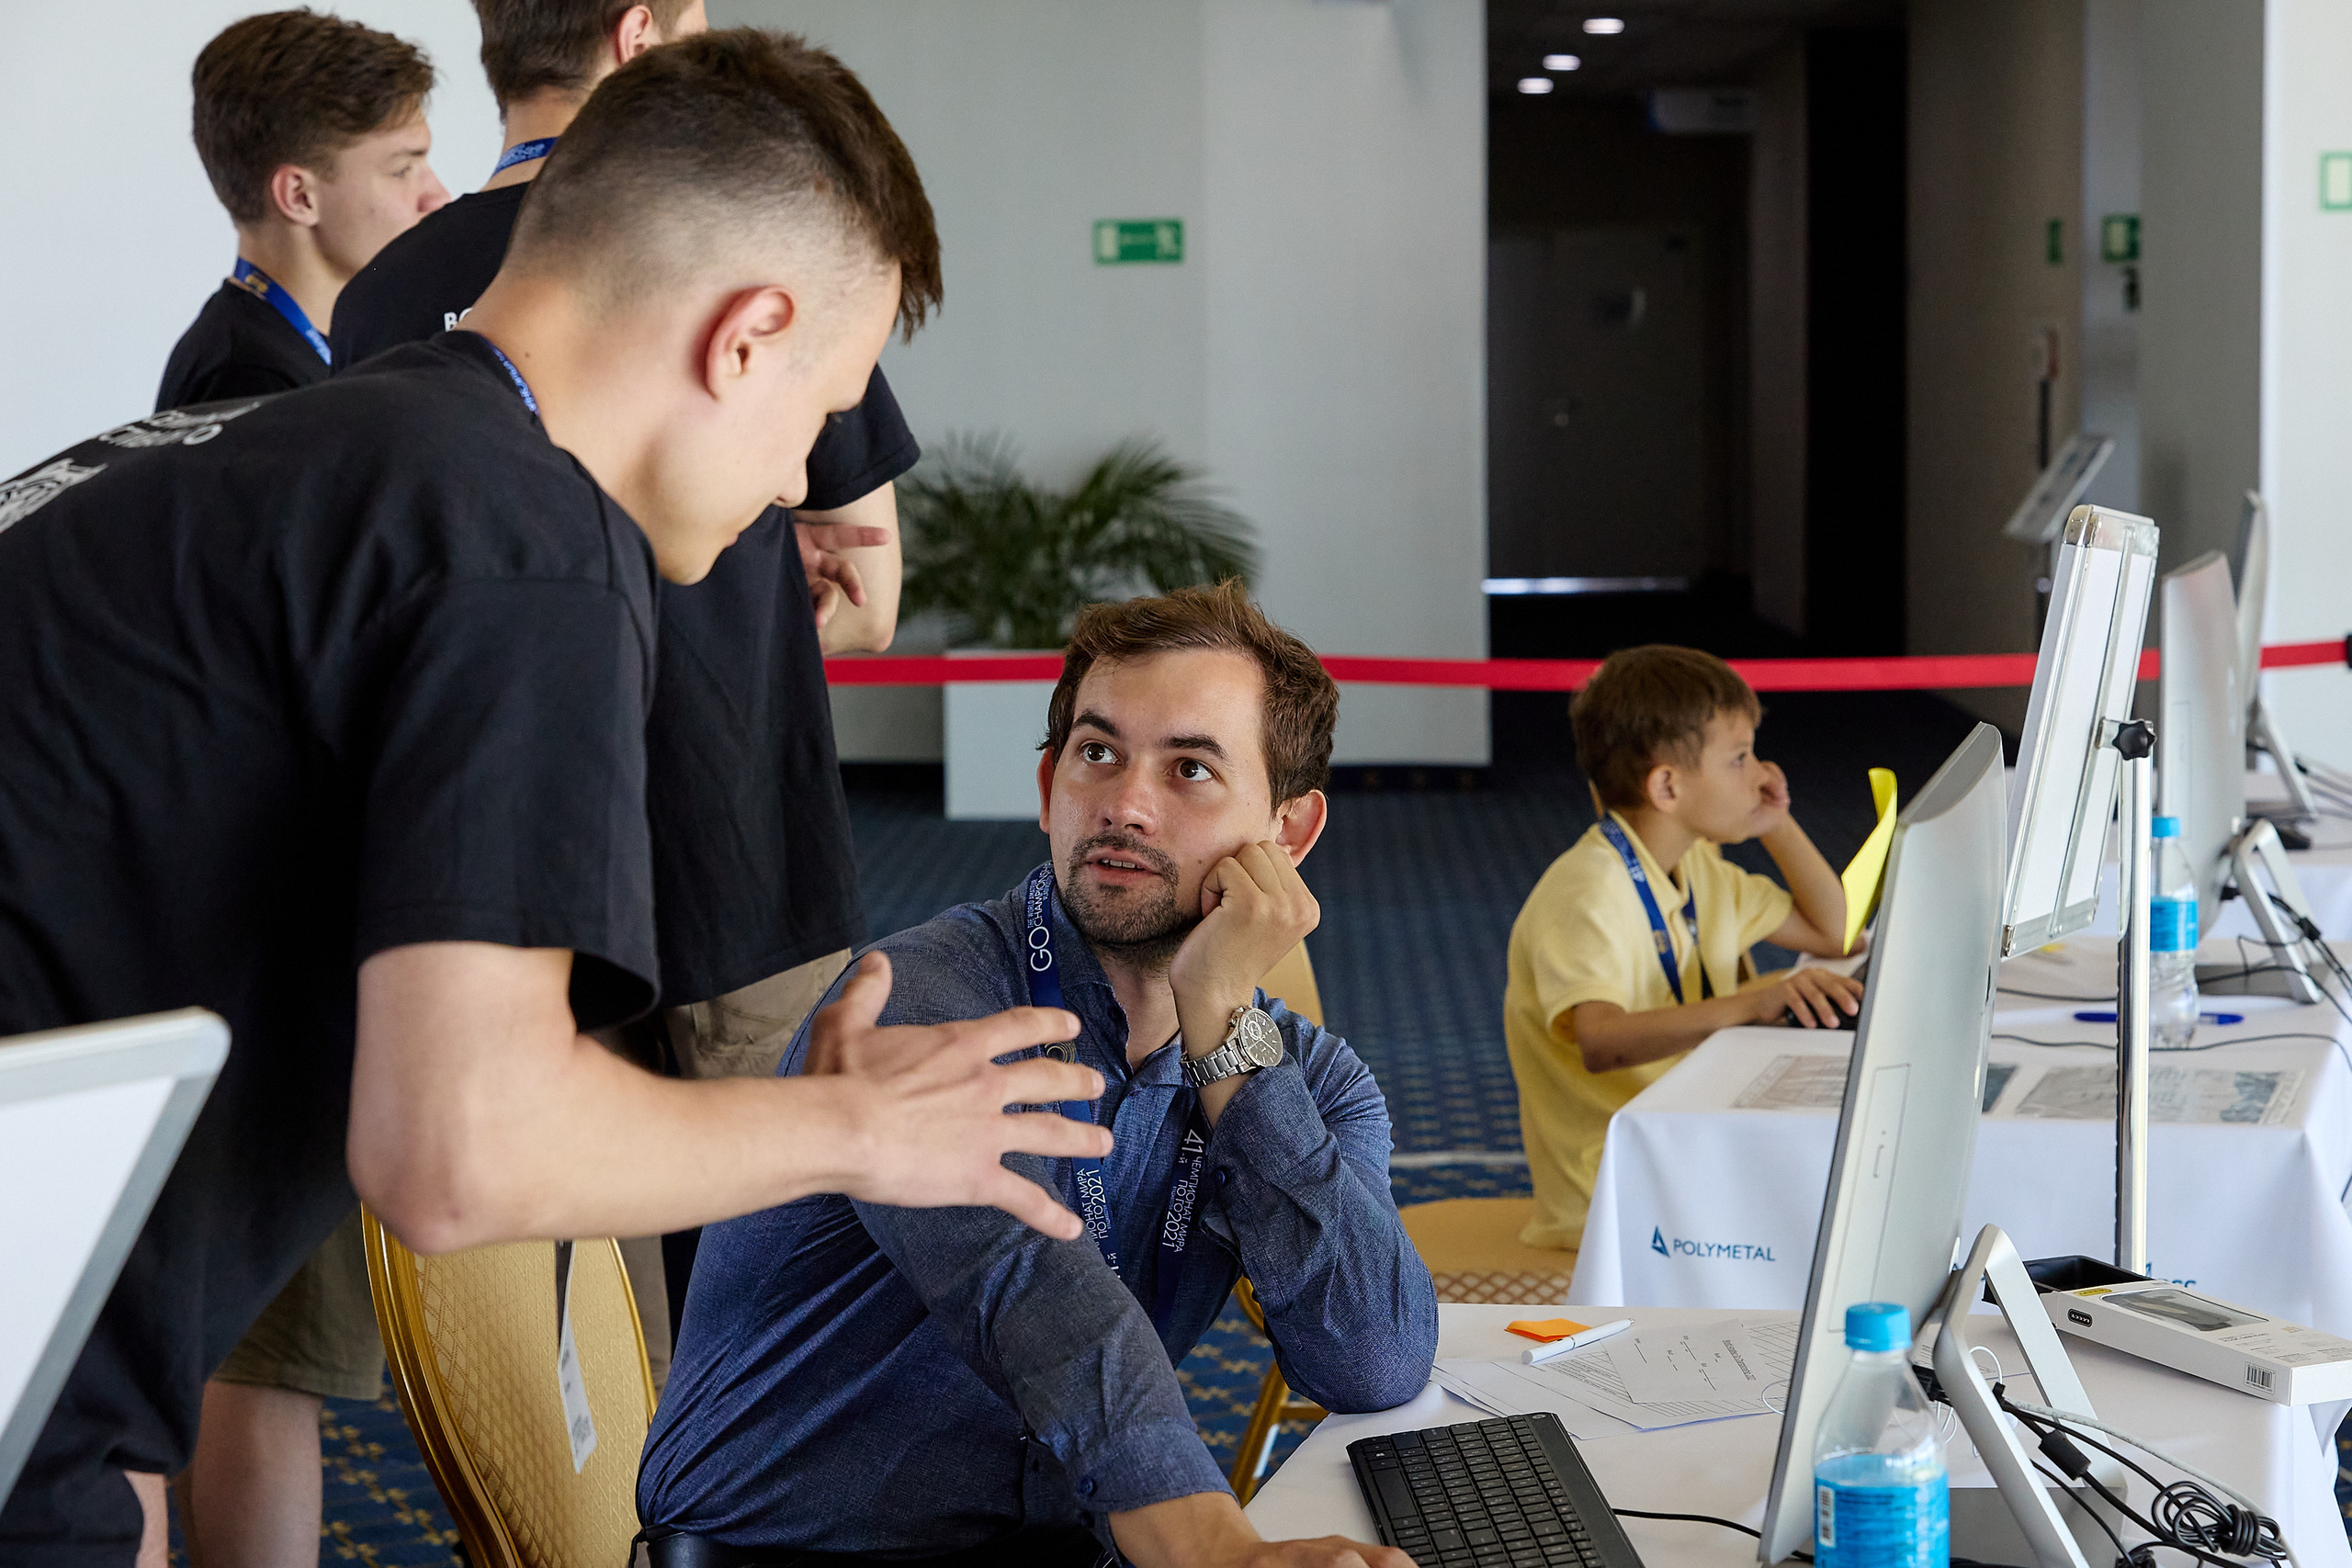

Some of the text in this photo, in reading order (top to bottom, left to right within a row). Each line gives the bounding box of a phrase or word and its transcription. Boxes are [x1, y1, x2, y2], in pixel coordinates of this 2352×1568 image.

[1028, 926, 1053, 972] GO
[1076, 1168, 1091, 1199] МИРА
[1173, 1129, 1204, 1253] 41-й ЧЕМПИОНАТ МИРА
[1176, 1179, 1188, 1197] ПО
[1096, 1222, 1109, 1239] ПО
[1673, 1238, 1776, 1261] POLYMETAL
